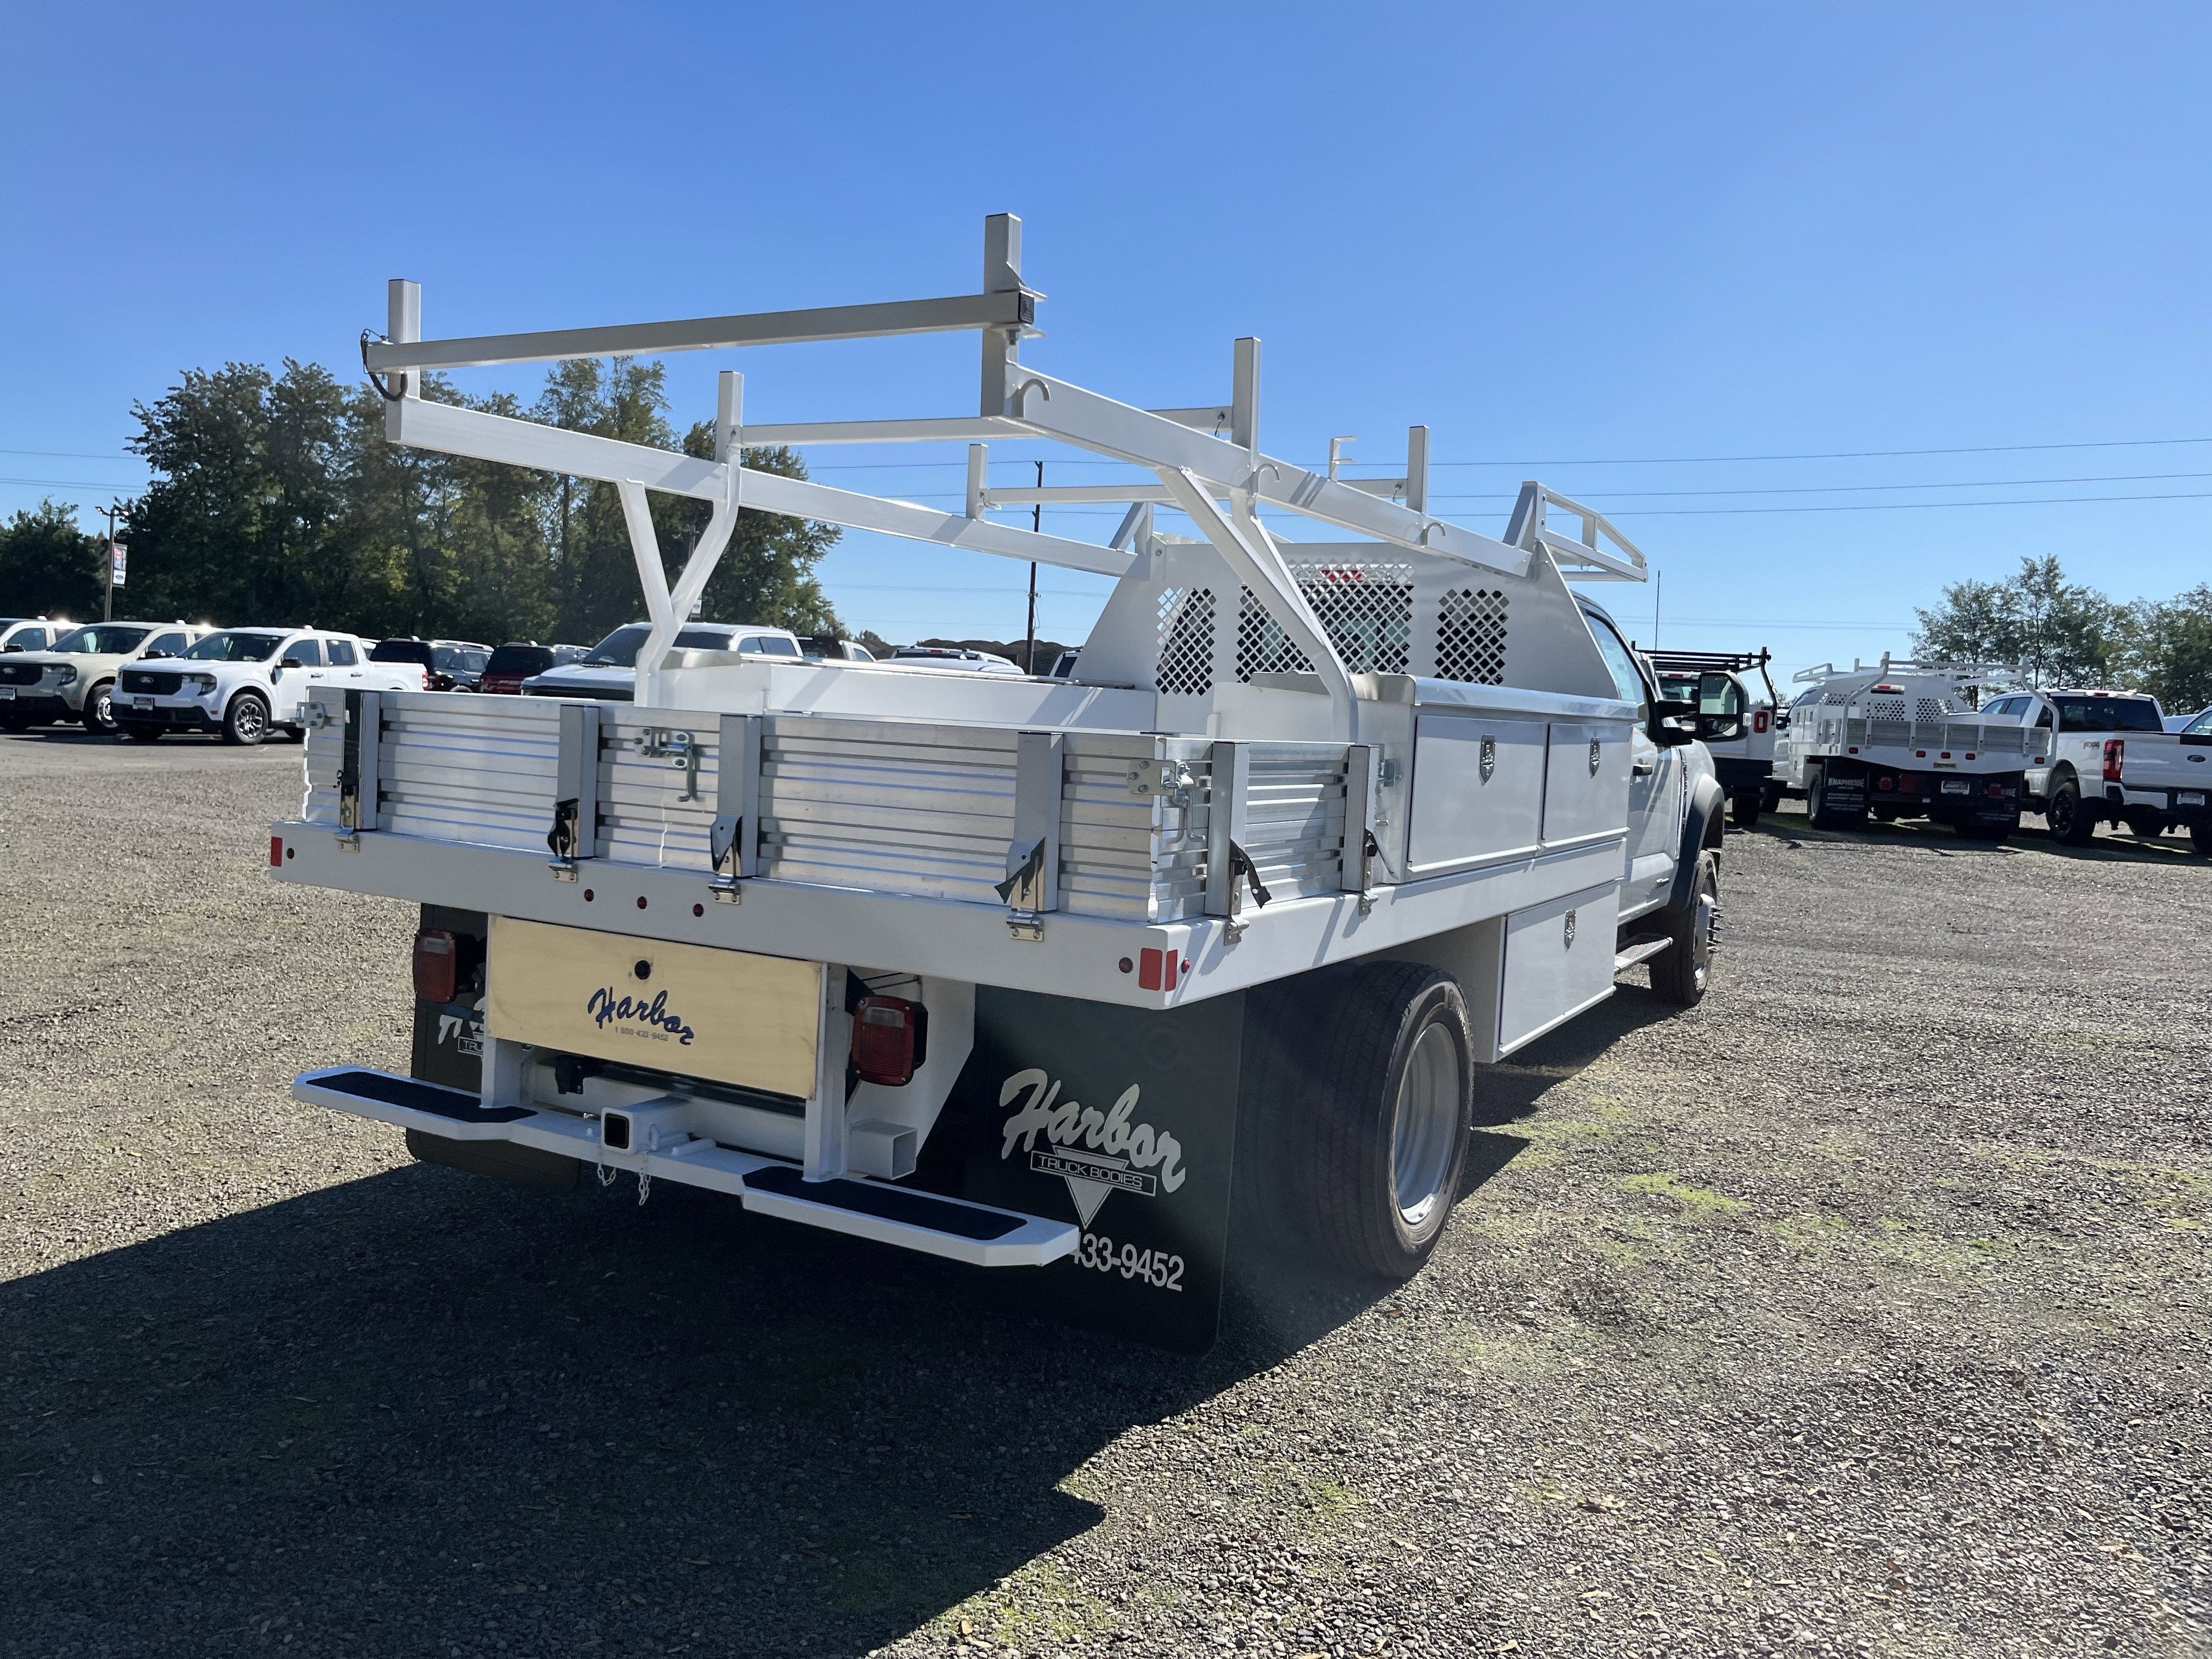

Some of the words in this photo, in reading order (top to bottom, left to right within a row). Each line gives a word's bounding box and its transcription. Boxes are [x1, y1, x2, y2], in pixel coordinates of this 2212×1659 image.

[588, 986, 695, 1045] Harbor
[999, 1068, 1187, 1193] Harbor
[1038, 1155, 1089, 1176] TRUCK
[1090, 1166, 1143, 1187] BODIES
